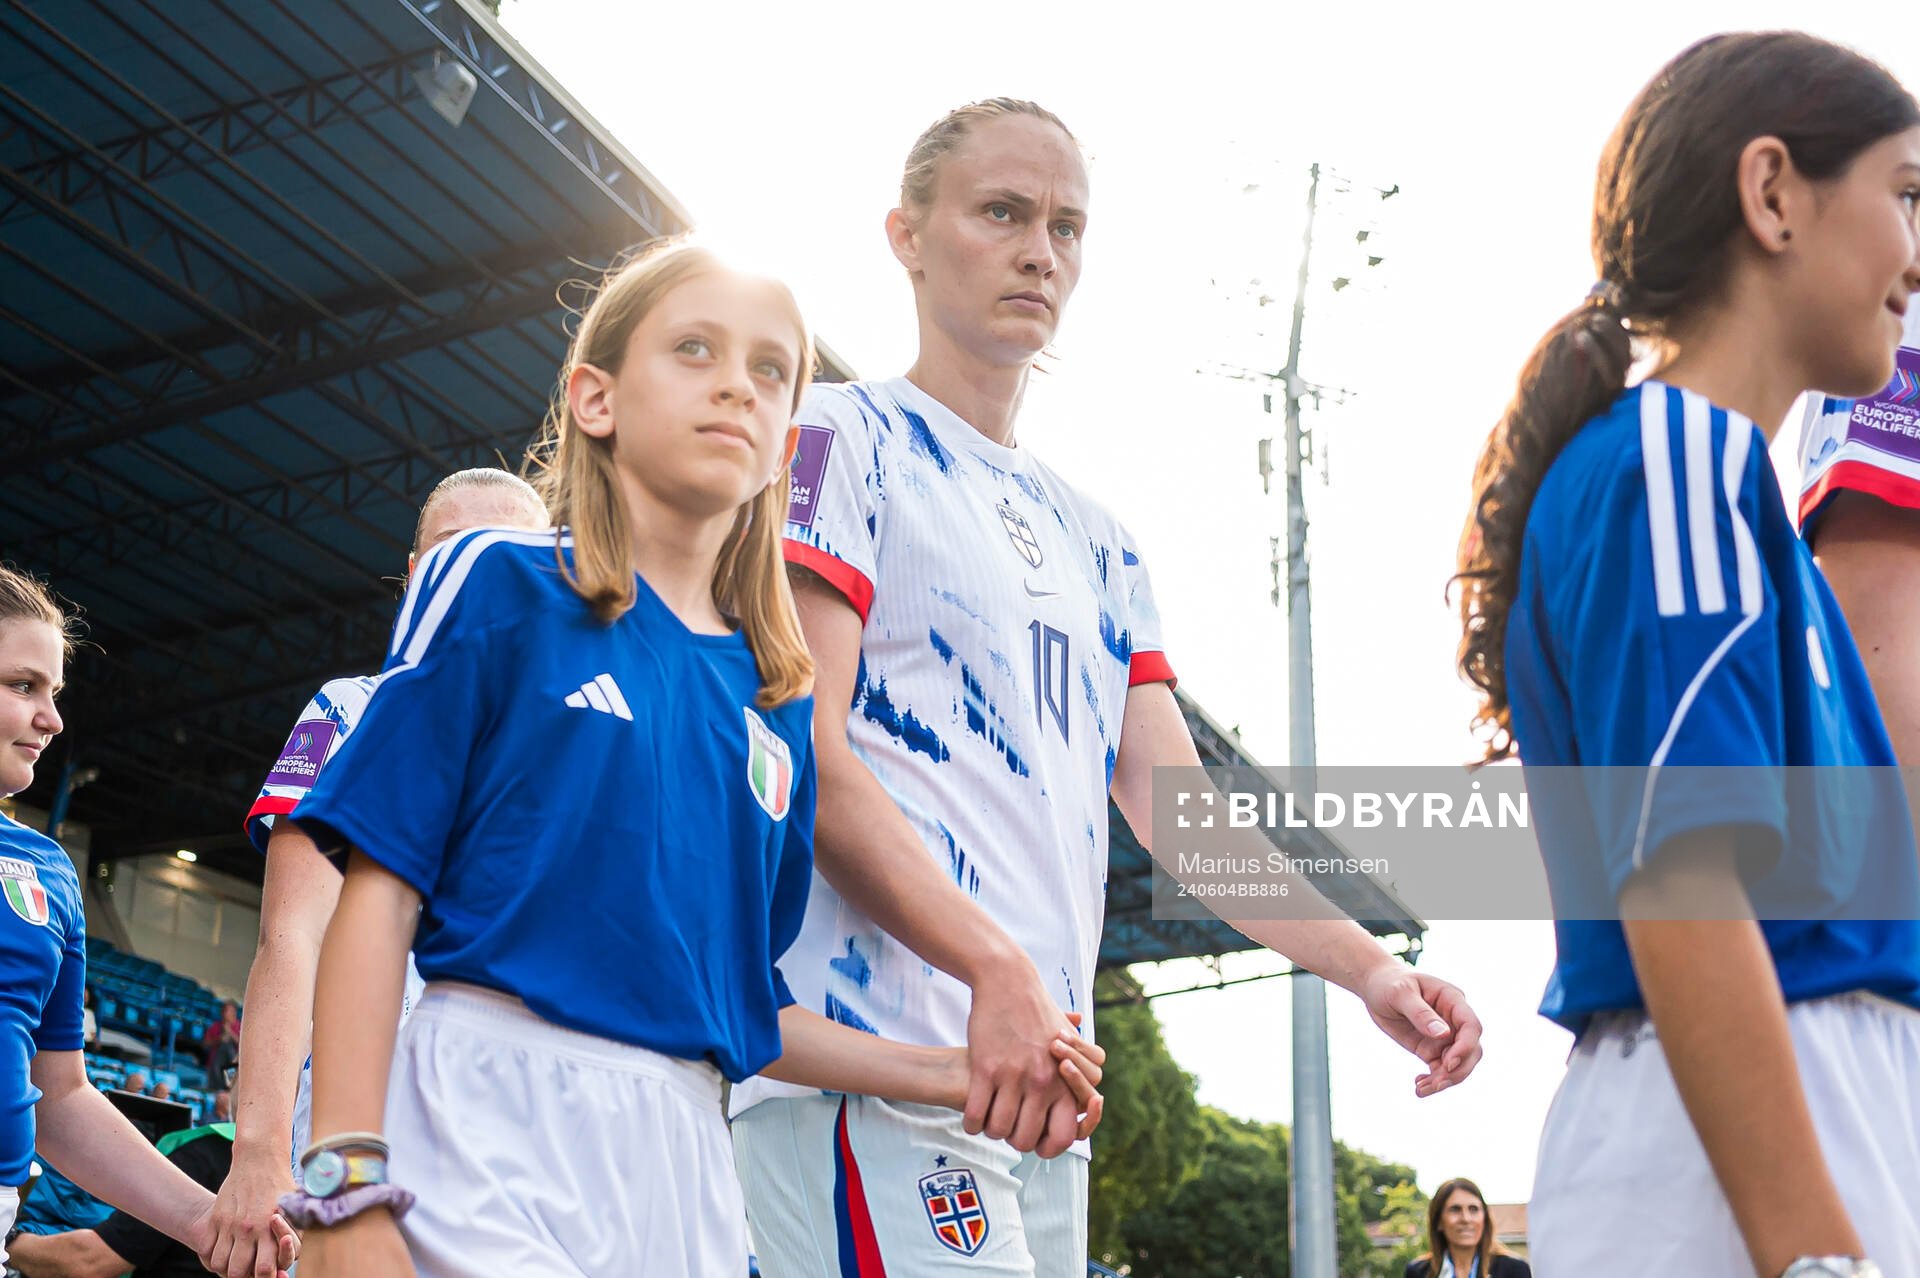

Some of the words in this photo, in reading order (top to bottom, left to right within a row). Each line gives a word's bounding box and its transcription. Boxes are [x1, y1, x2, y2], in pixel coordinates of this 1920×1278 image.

[1851, 413, 1920, 440] QUALIFIER
[1855, 403, 1920, 427] EUROPEA
[1027, 619, 1069, 751] 10
[275, 759, 317, 769] UROPEAN
